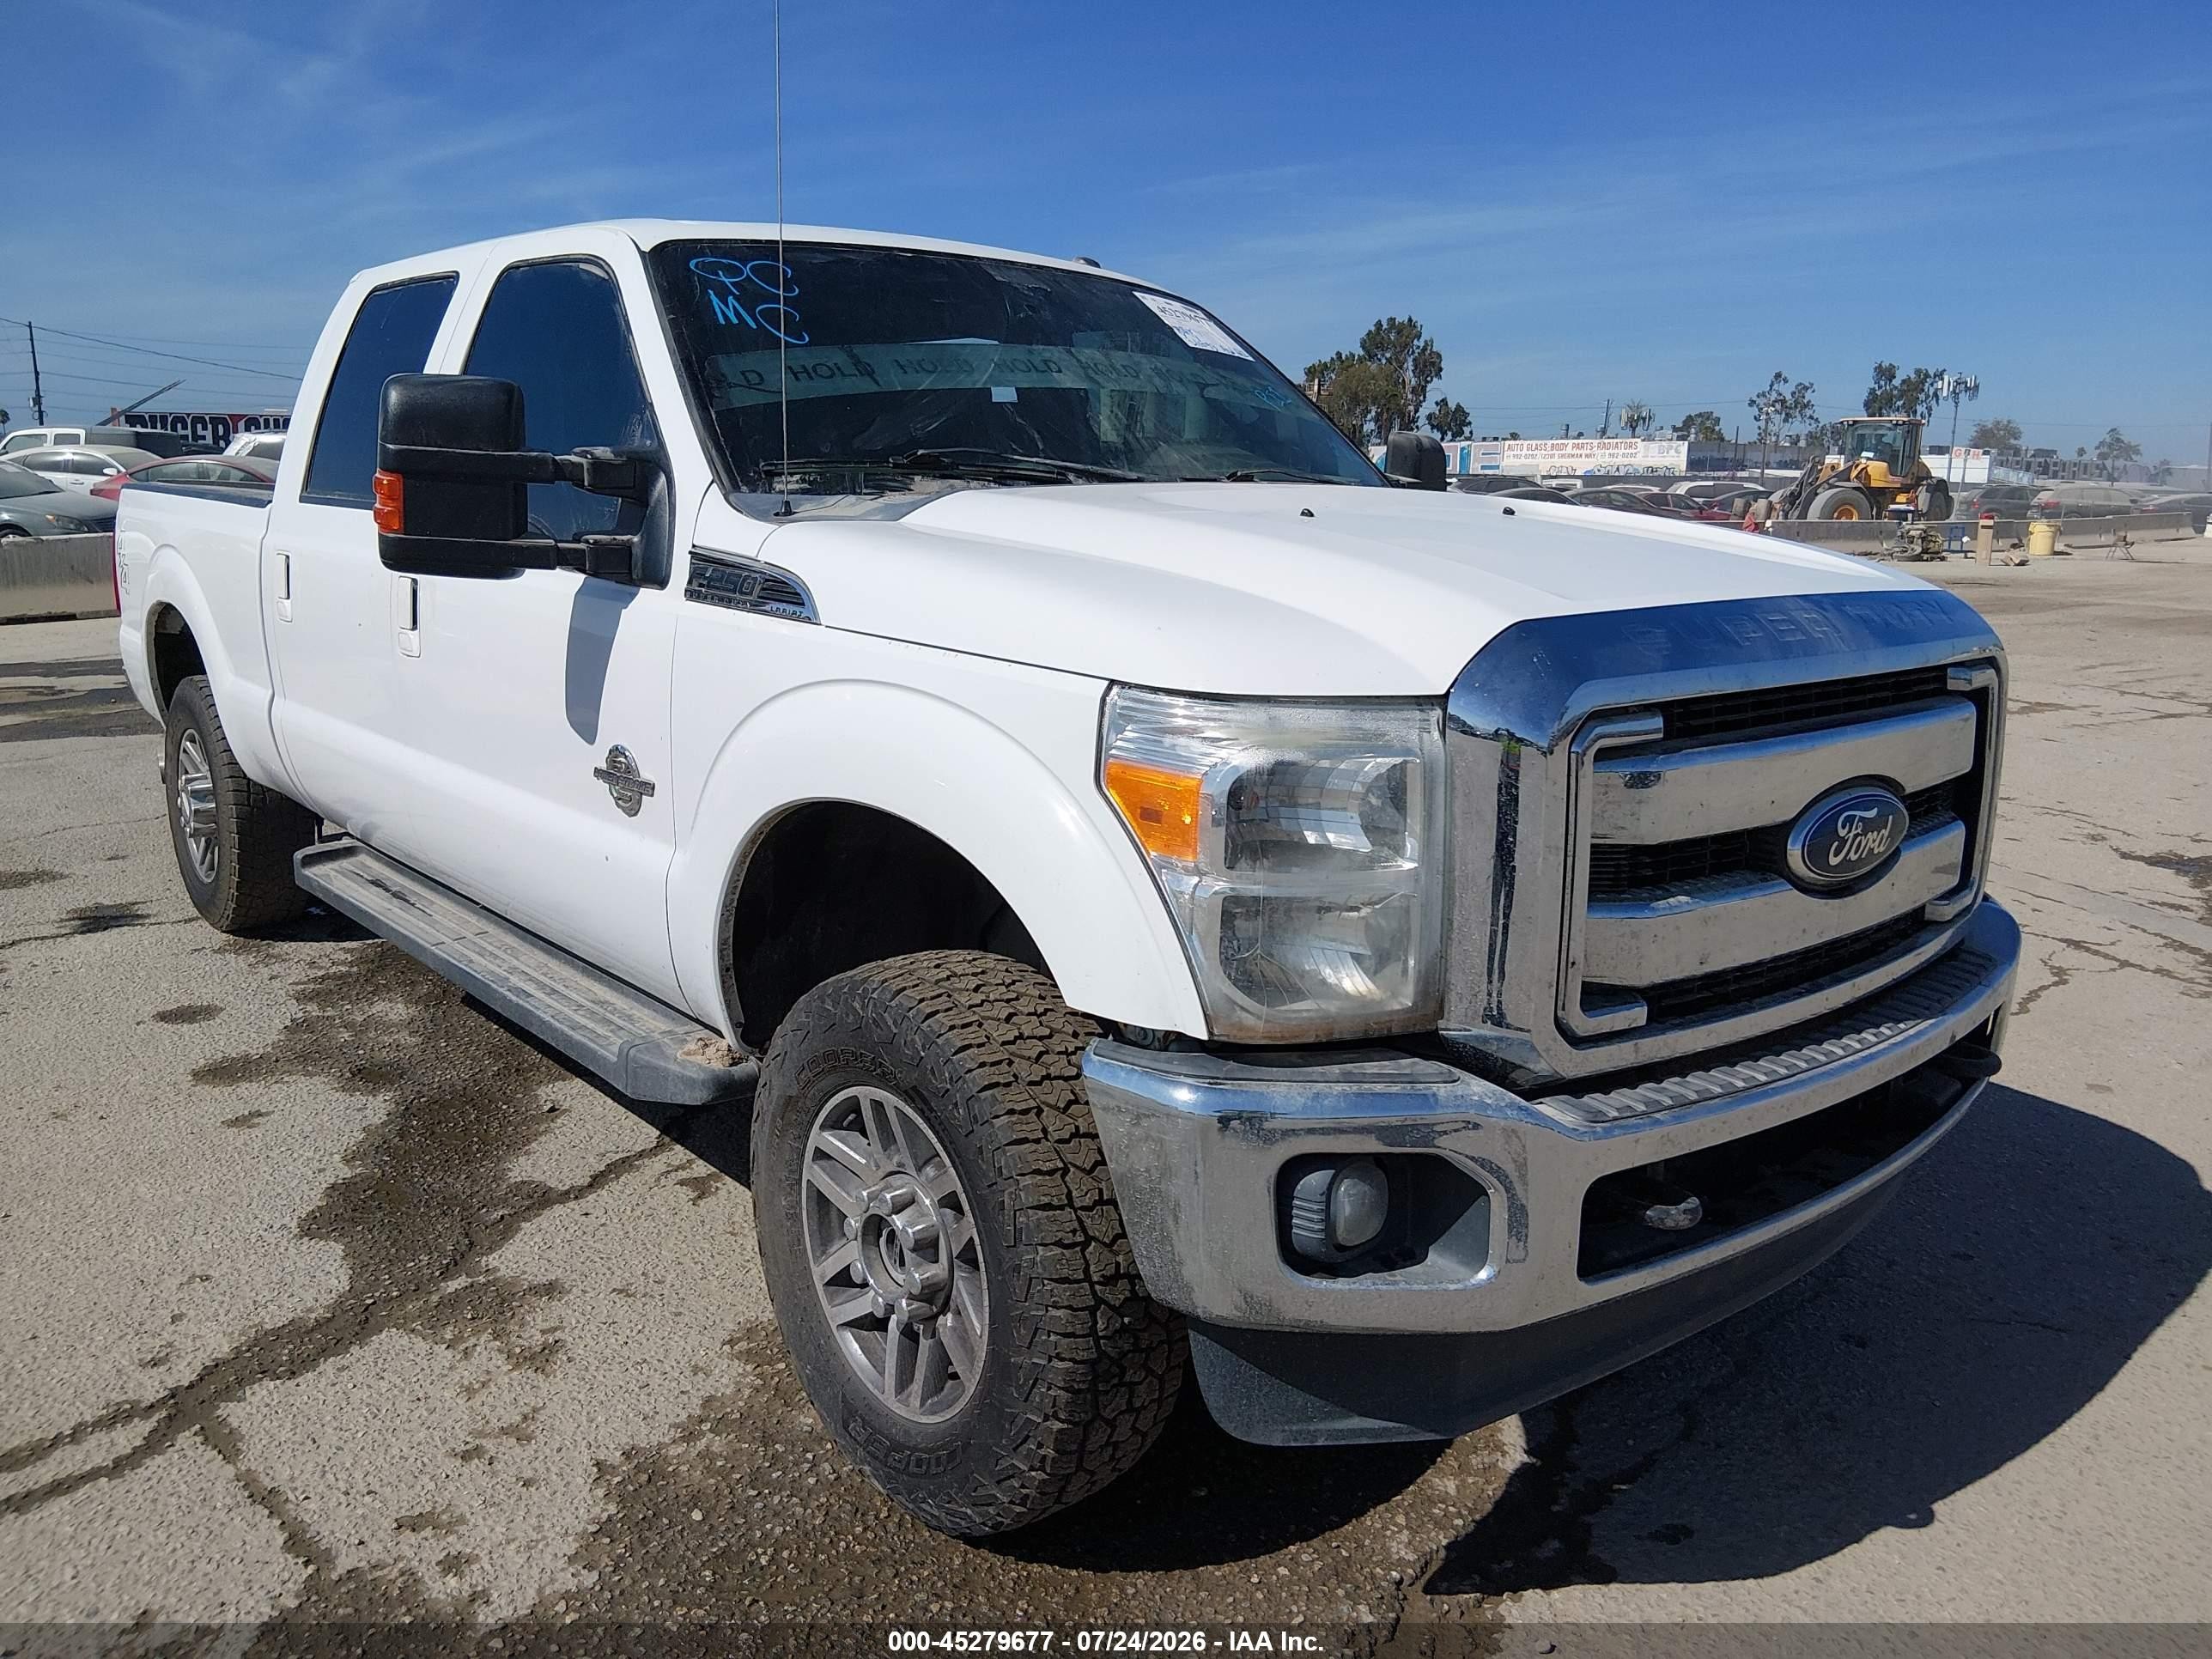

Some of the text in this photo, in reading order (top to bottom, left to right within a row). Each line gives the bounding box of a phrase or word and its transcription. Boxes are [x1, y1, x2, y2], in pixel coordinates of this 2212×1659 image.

[708, 289, 810, 344] MC
[787, 361, 876, 383] HOLD
[991, 357, 1063, 374] HOLD
[1506, 442, 1524, 452] AUTO
[770, 605, 804, 617] LARIAT
[1828, 807, 1893, 866] Ford
[794, 1046, 897, 1092] COOPER
